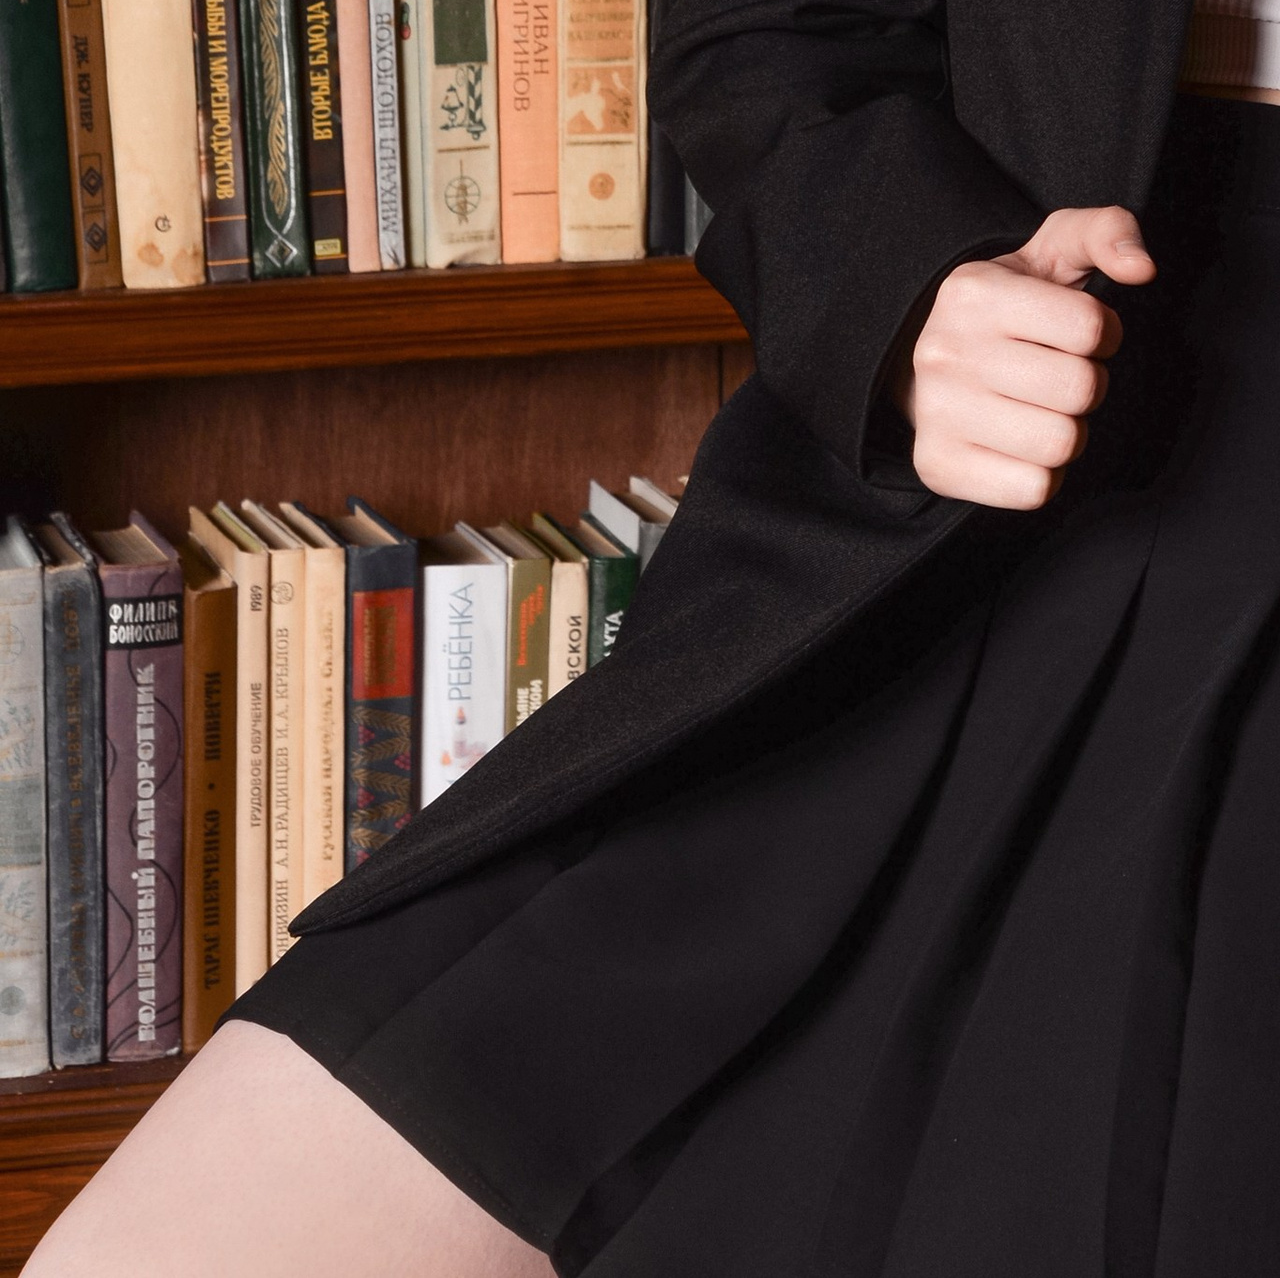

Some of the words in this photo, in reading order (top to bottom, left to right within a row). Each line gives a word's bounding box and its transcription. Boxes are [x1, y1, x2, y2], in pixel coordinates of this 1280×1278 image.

[208, 39, 227, 54] И
[306, 1, 330, 66] БЛЮДА
[532, 4, 550, 75] ИВАН
[77, 72, 94, 134] КУПЕР
[309, 68, 333, 141] ВТОРЫЕ
[374, 12, 396, 129] ШОЛОХОВ
[209, 55, 235, 200] МОРЕПРОДУКТОВ
[379, 137, 399, 235] МИХАИЛ
[250, 584, 263, 613] 1989
[274, 627, 290, 701] КРЫЛОВ
[443, 582, 474, 701] РЕБЁНКА
[203, 671, 221, 762] ПОВЕСТИ
[249, 682, 262, 755] ОБУЧЕНИЕ
[135, 661, 156, 861] ПАПОРОТНИК
[249, 757, 263, 829] ТРУДОВОЕ
[203, 808, 221, 927] ШЕВЧЕНКО
[130, 866, 156, 1042] ВОЛШЕБНЫЙ
[203, 932, 221, 990] ТАРАС
